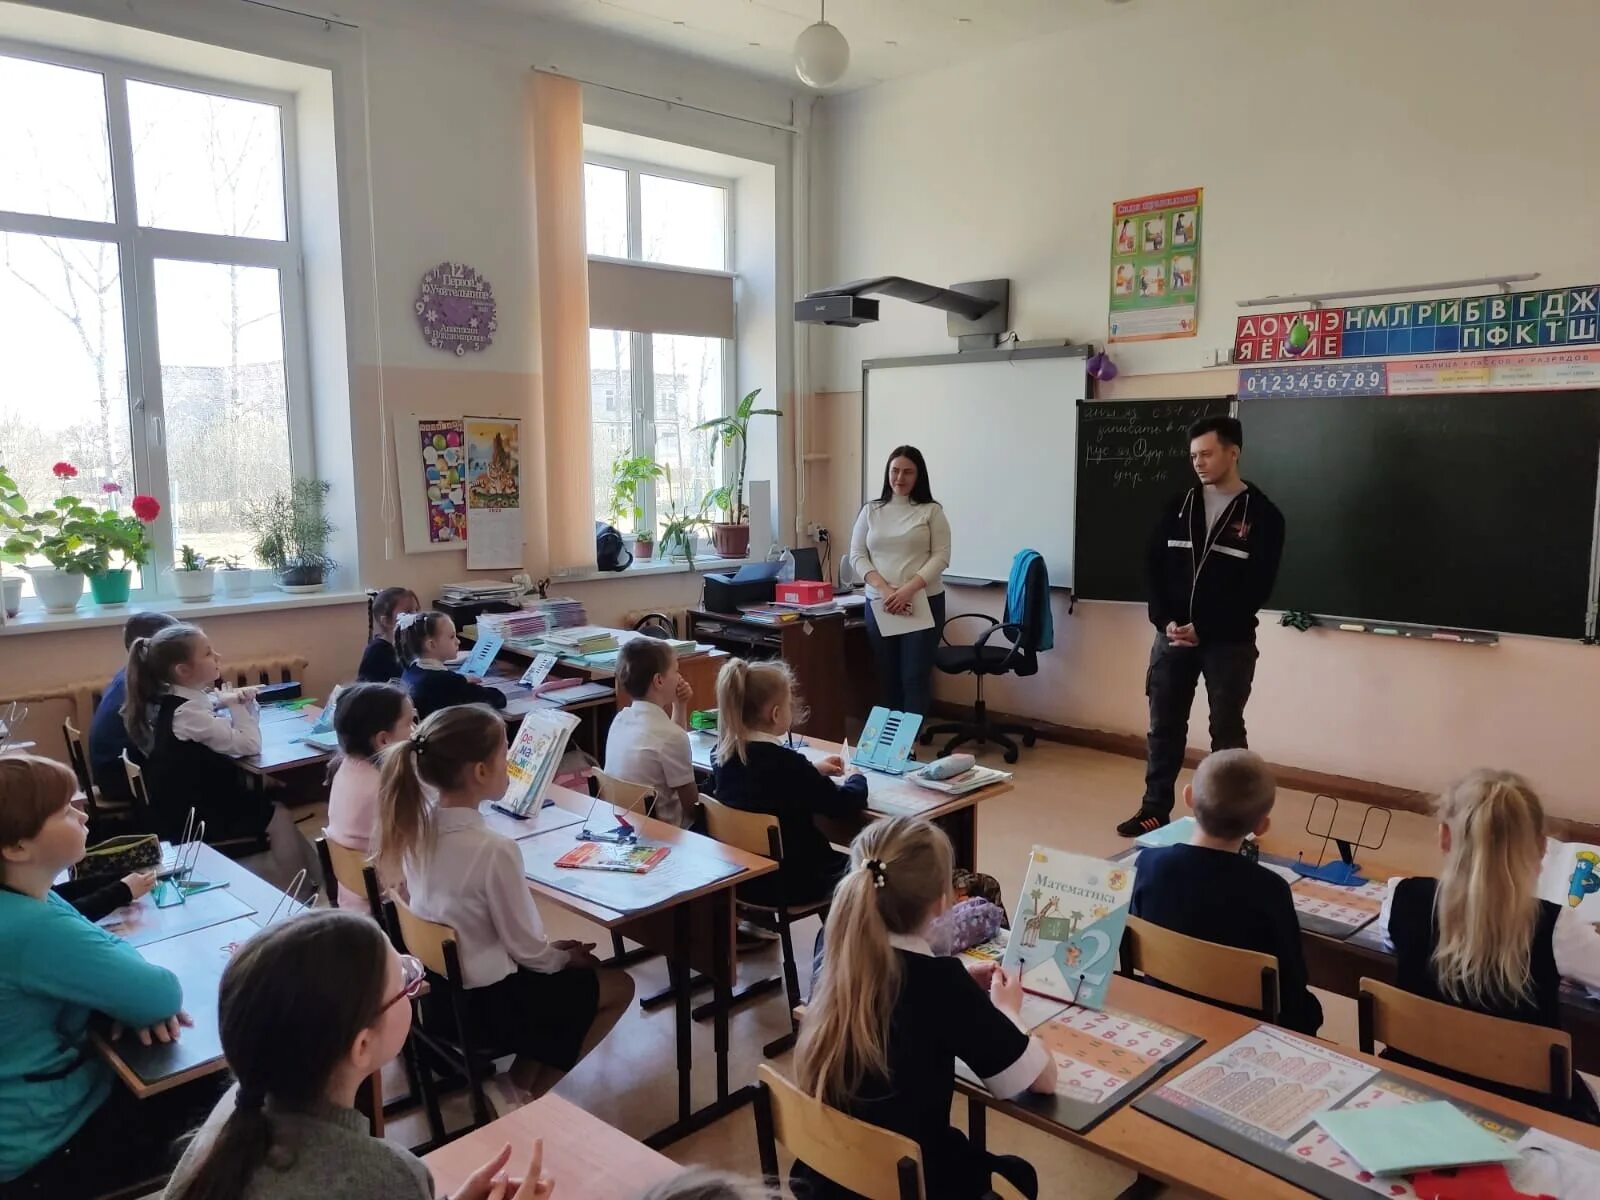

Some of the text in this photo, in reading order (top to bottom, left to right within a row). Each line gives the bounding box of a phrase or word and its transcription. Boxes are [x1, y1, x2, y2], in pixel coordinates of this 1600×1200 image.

[451, 264, 464, 277] 12
[1035, 873, 1116, 903] Математика
[1070, 929, 1112, 985] 2
